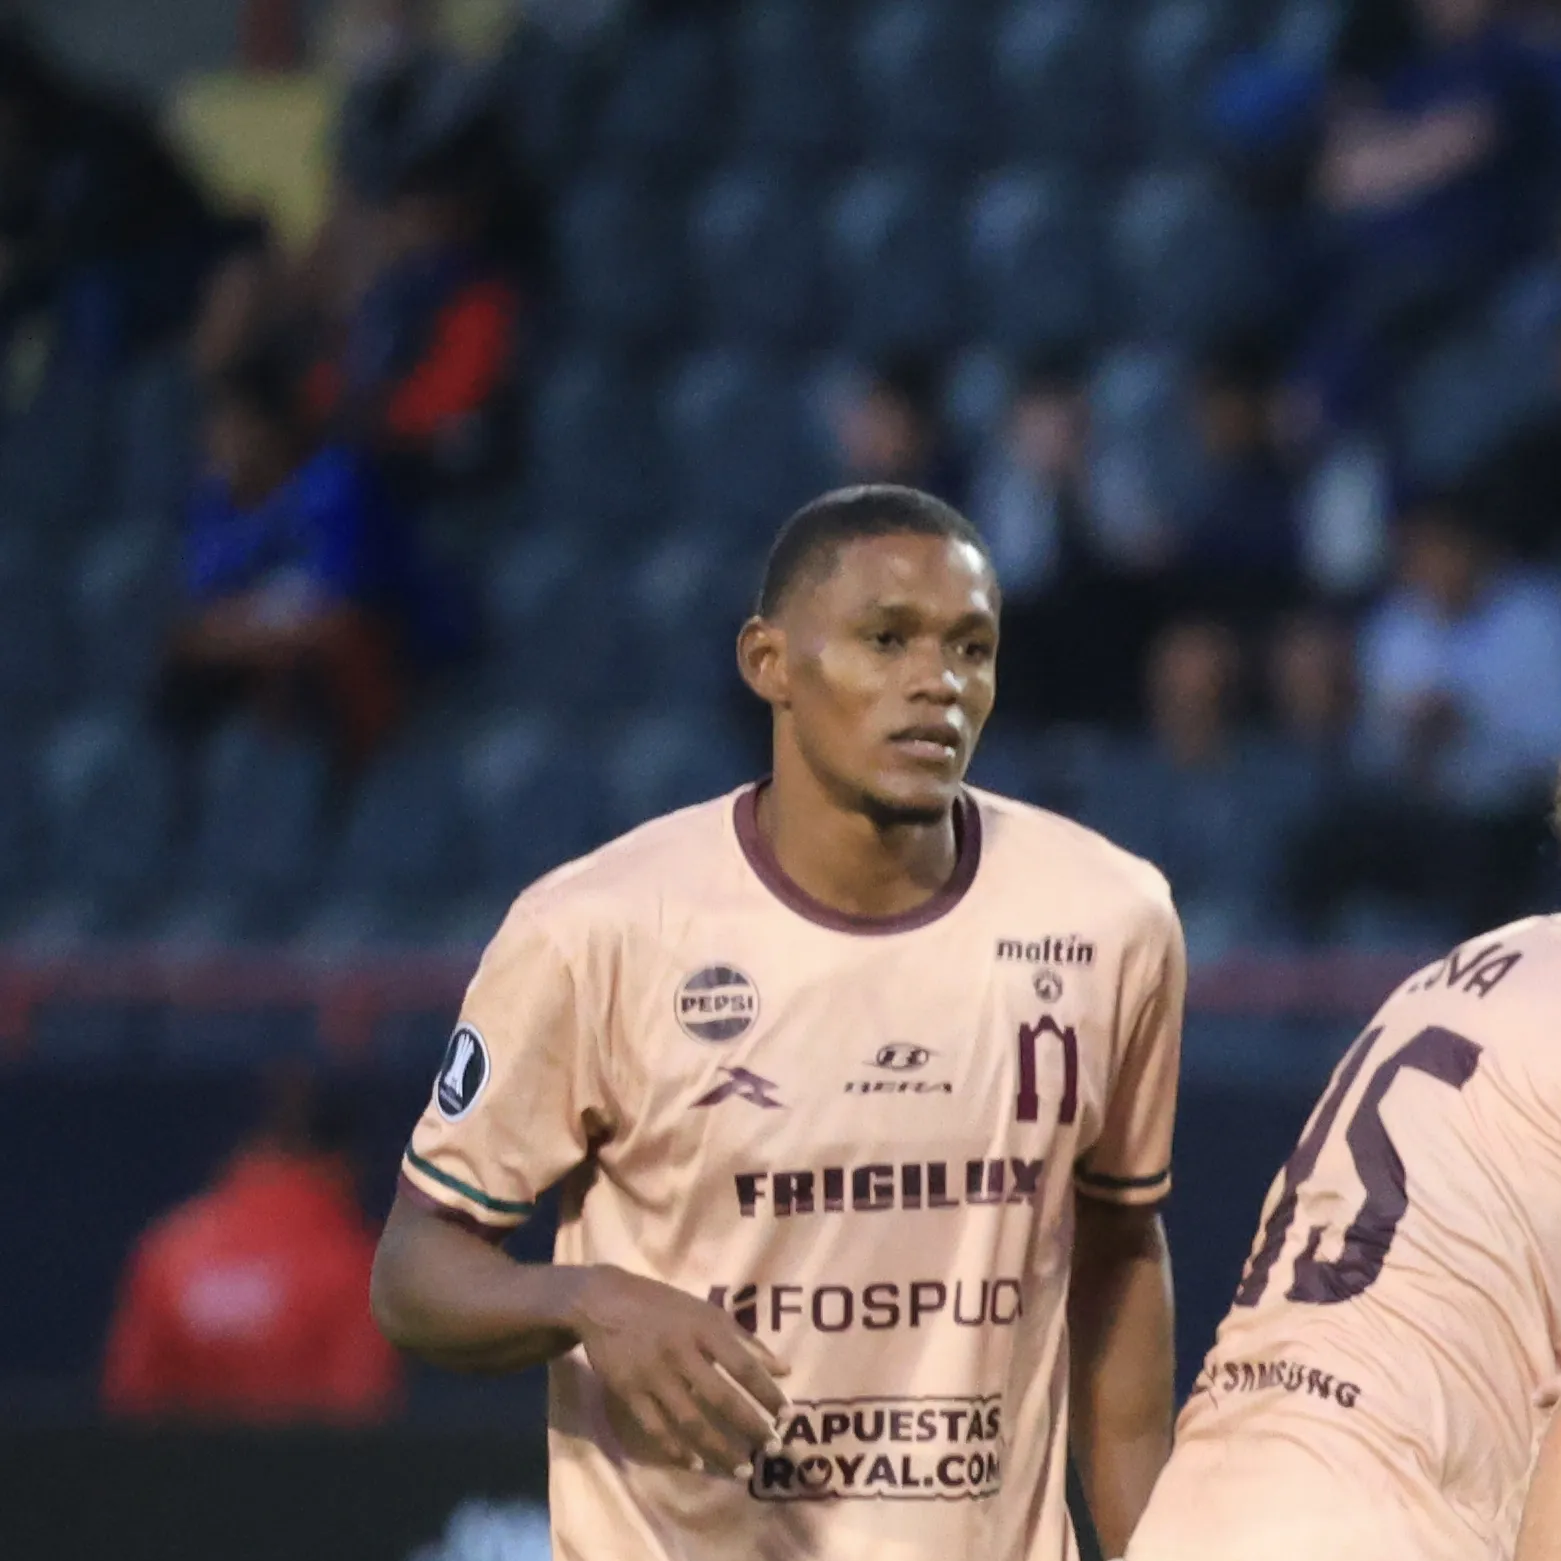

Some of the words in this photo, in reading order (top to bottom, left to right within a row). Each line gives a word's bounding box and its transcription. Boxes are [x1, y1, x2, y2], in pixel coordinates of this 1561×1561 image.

[680, 995, 754, 1014] PEPSI
[734, 1157, 1044, 1218] FRIGILUX
[1232, 1025, 1484, 1308] 15
[782, 1406, 1001, 1446] APUESTAS
